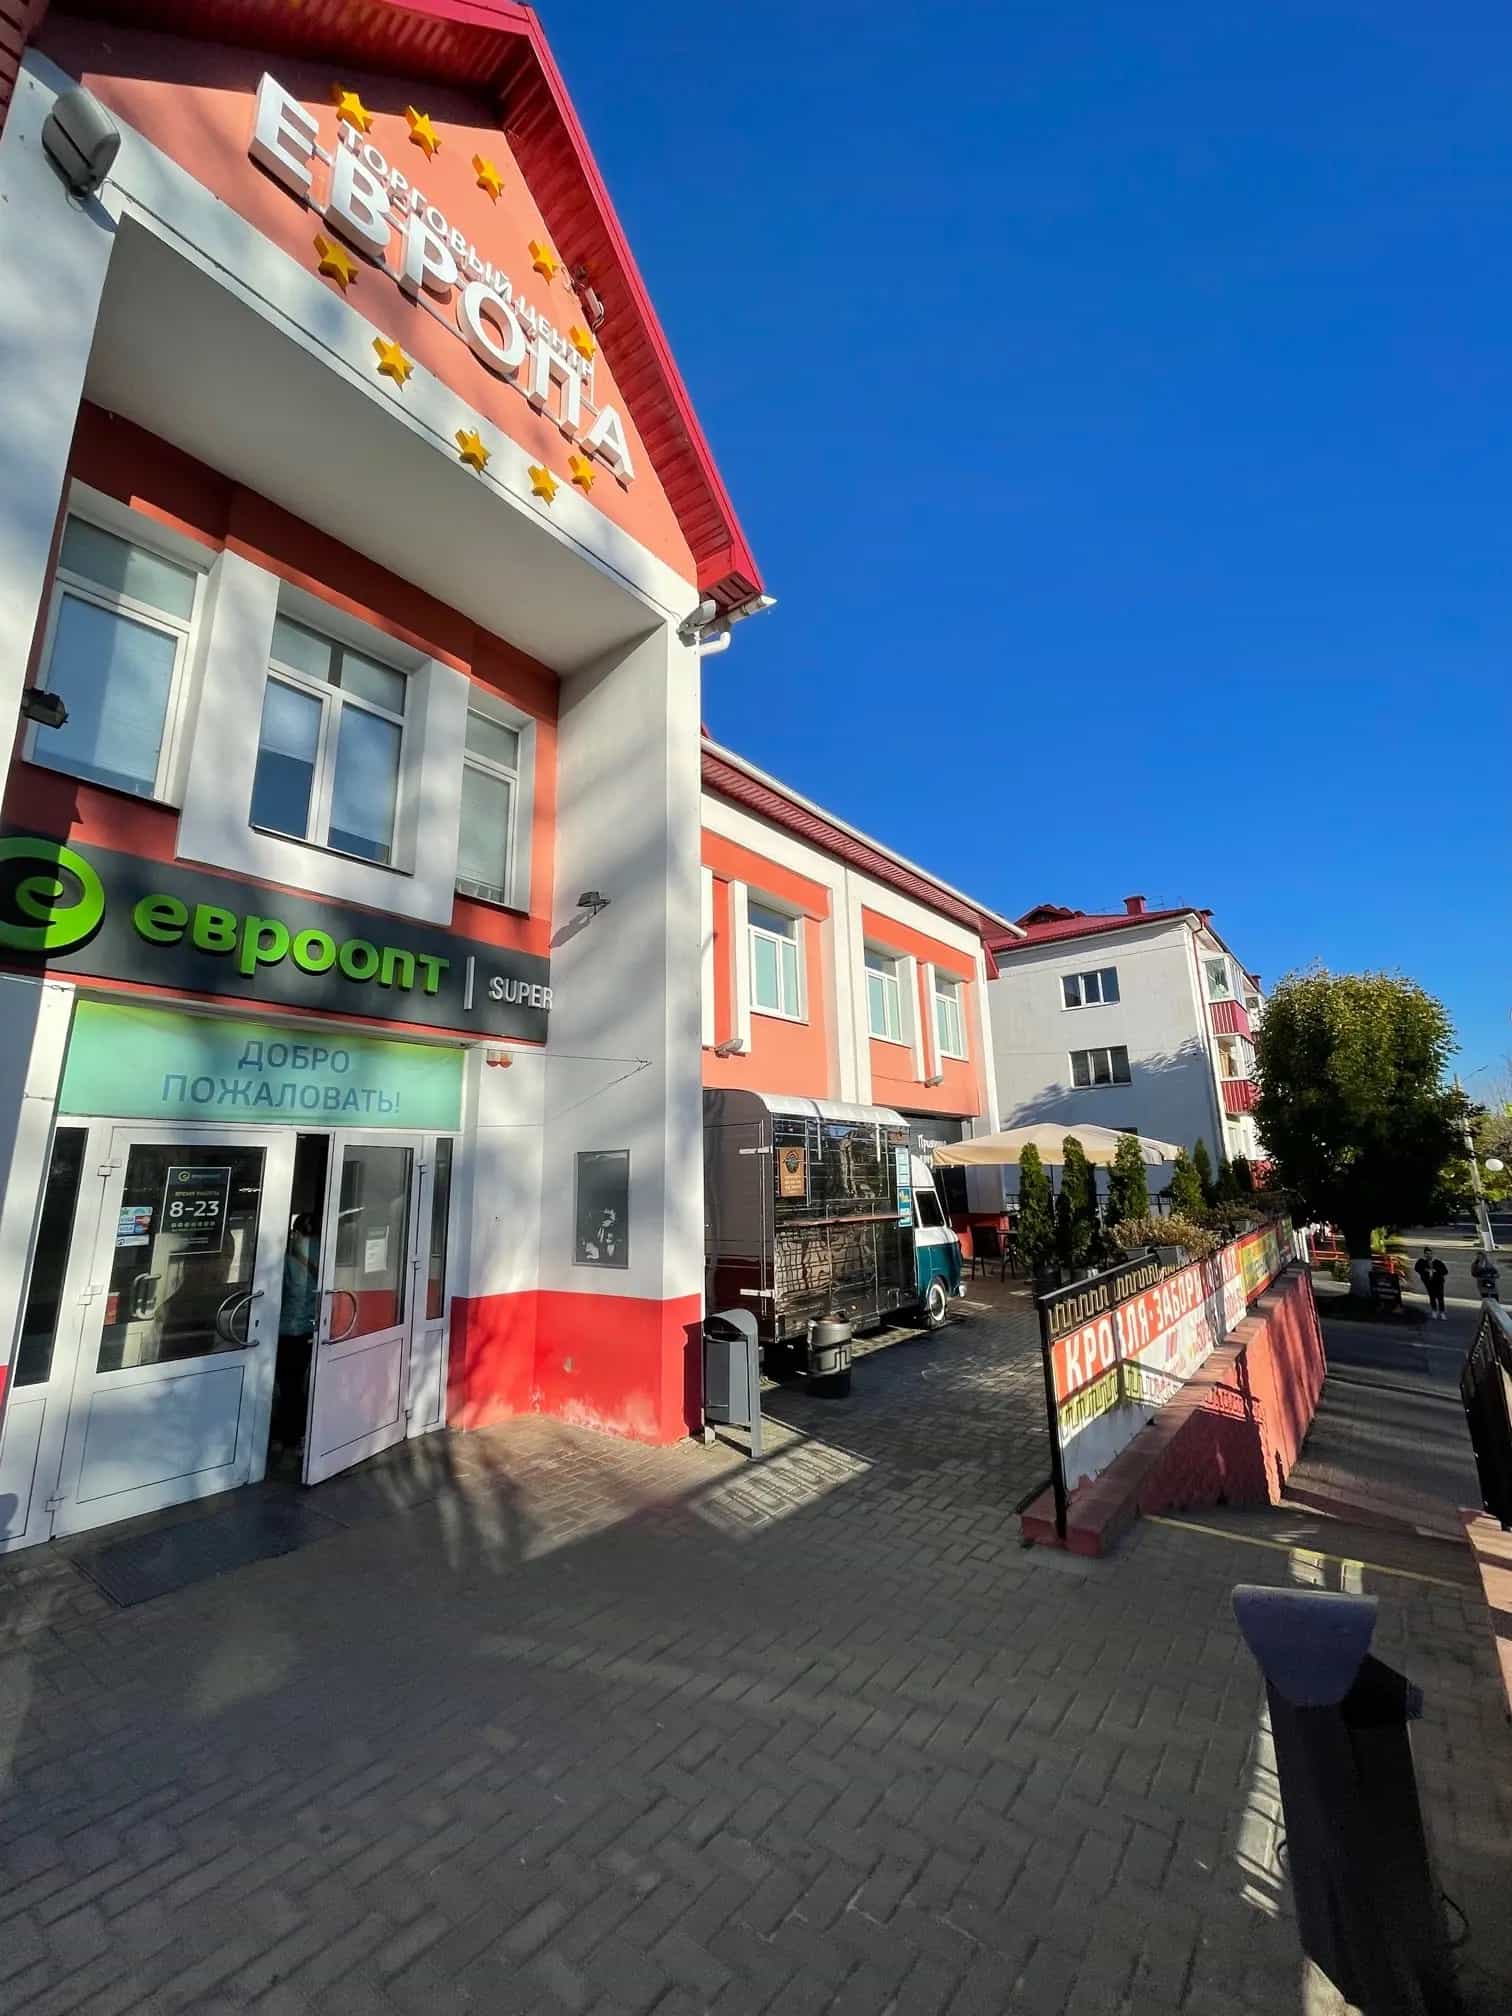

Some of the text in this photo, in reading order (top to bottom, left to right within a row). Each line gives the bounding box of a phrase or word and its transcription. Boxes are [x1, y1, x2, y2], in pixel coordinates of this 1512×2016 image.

[338, 117, 512, 303] ТОРГОВЫЙ
[248, 72, 634, 486] ЕВРОПА
[132, 893, 553, 1010] евроопт SUPER
[162, 1074, 401, 1114] ПОЖАЛОВАТЬ!
[238, 1040, 350, 1074] ДОБРО
[169, 1200, 220, 1218] 8-23
